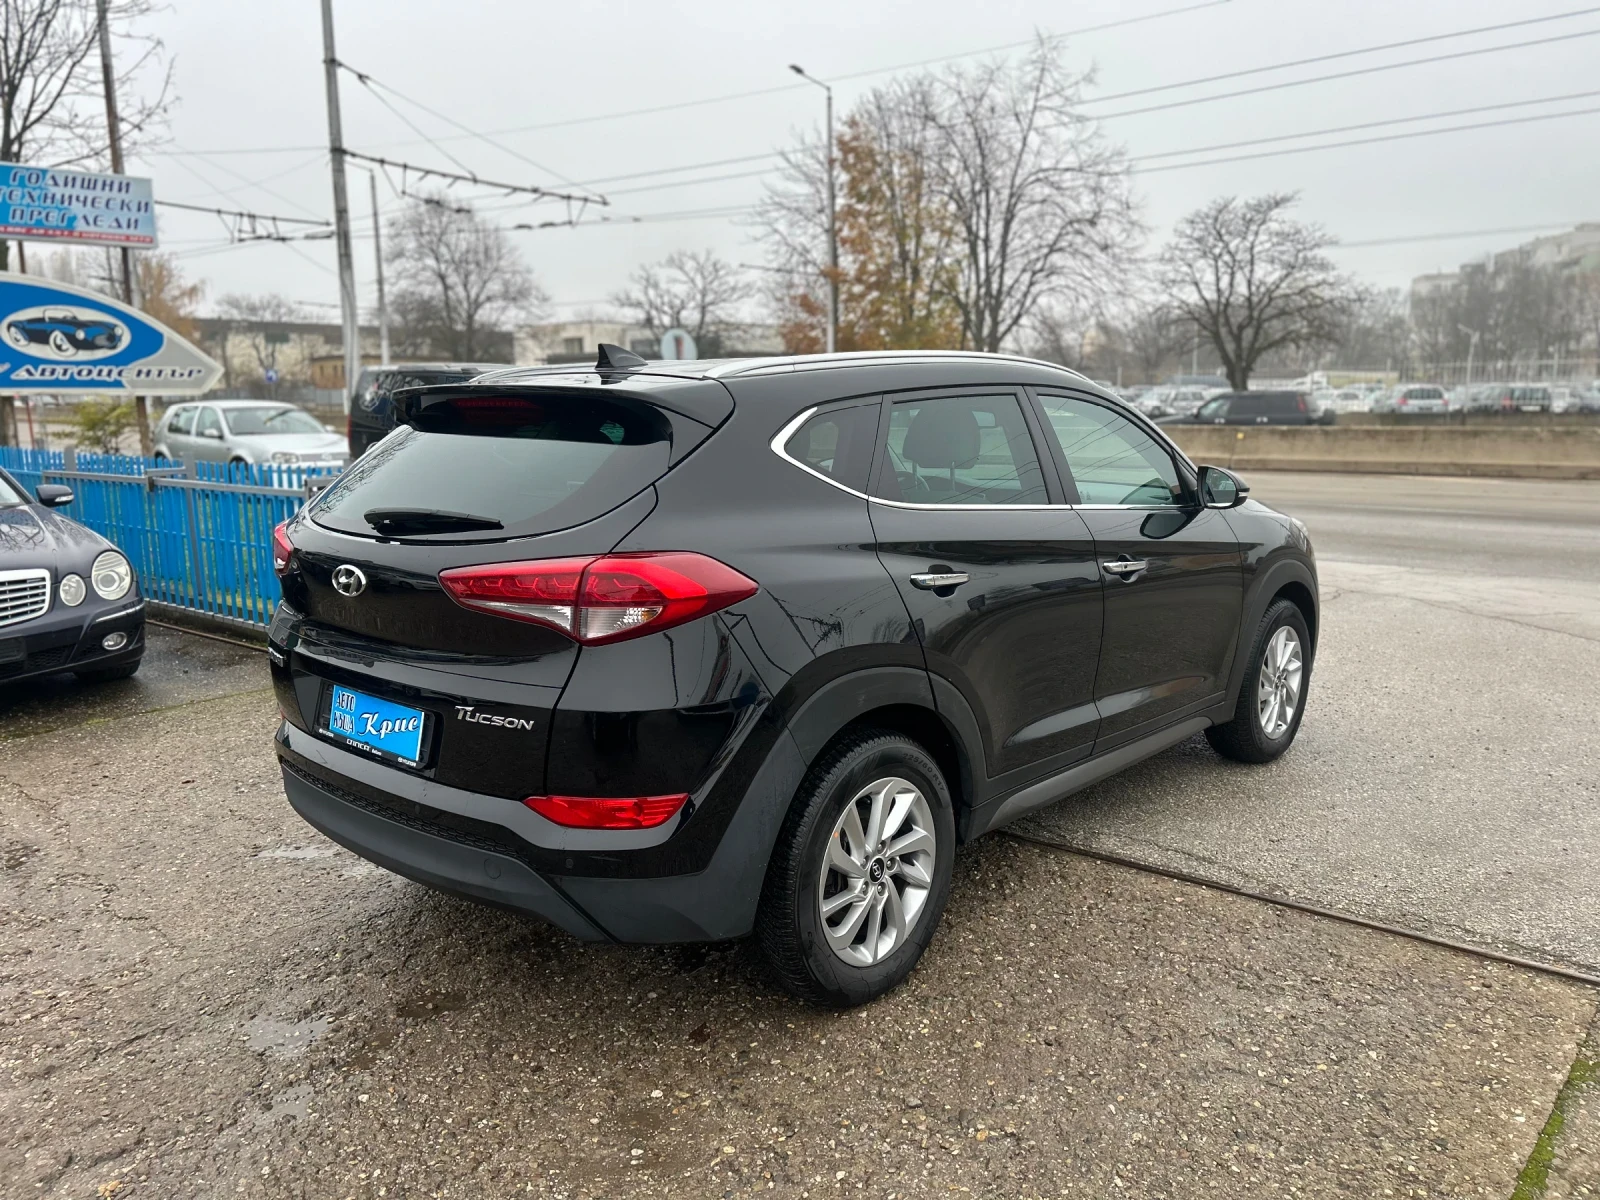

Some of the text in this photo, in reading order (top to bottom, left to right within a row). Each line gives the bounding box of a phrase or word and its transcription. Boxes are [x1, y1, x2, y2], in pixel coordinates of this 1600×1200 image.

[11, 169, 131, 194] ГОДИШНИ
[11, 365, 202, 382] АВТОЦЕНТЪР
[357, 711, 419, 740] Крис
[454, 705, 534, 730] TUCSON
